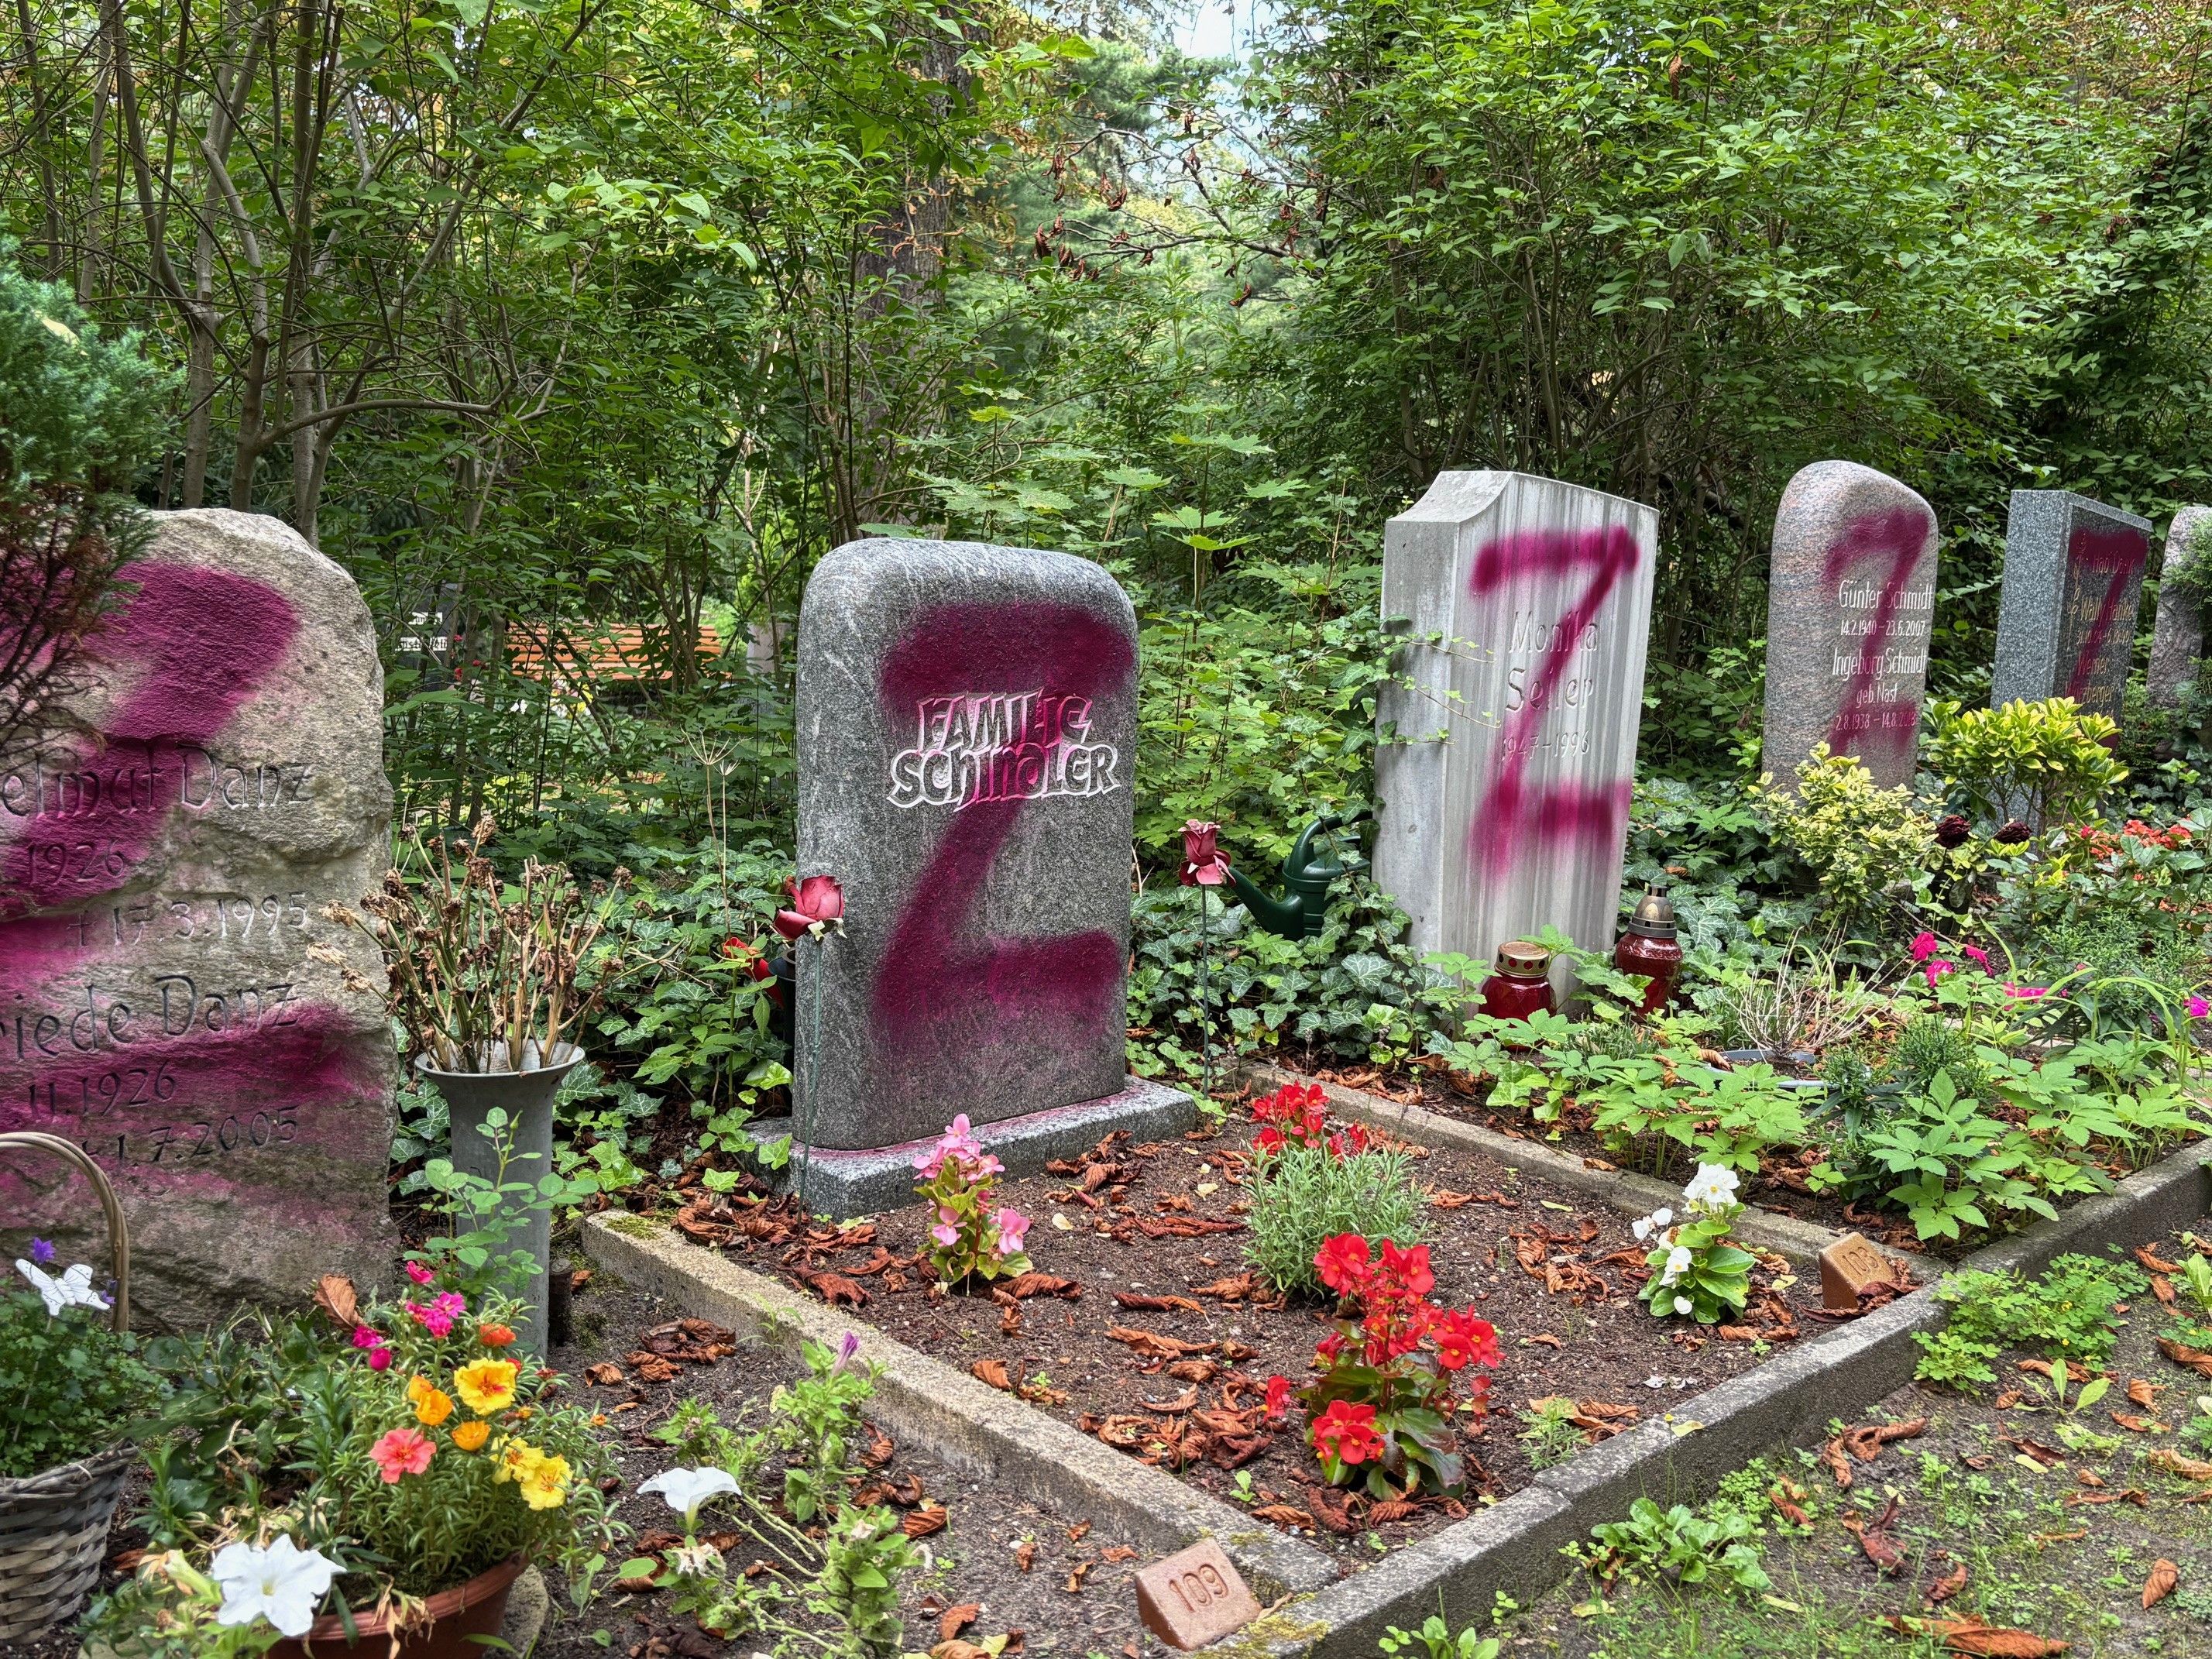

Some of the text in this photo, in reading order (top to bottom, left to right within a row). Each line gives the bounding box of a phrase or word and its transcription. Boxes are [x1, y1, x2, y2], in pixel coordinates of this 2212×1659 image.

[1839, 580, 1932, 610] Günter Schmidt
[177, 744, 314, 809] Danz
[155, 974, 301, 1036] Danz
[1170, 1563, 1229, 1613] 109
